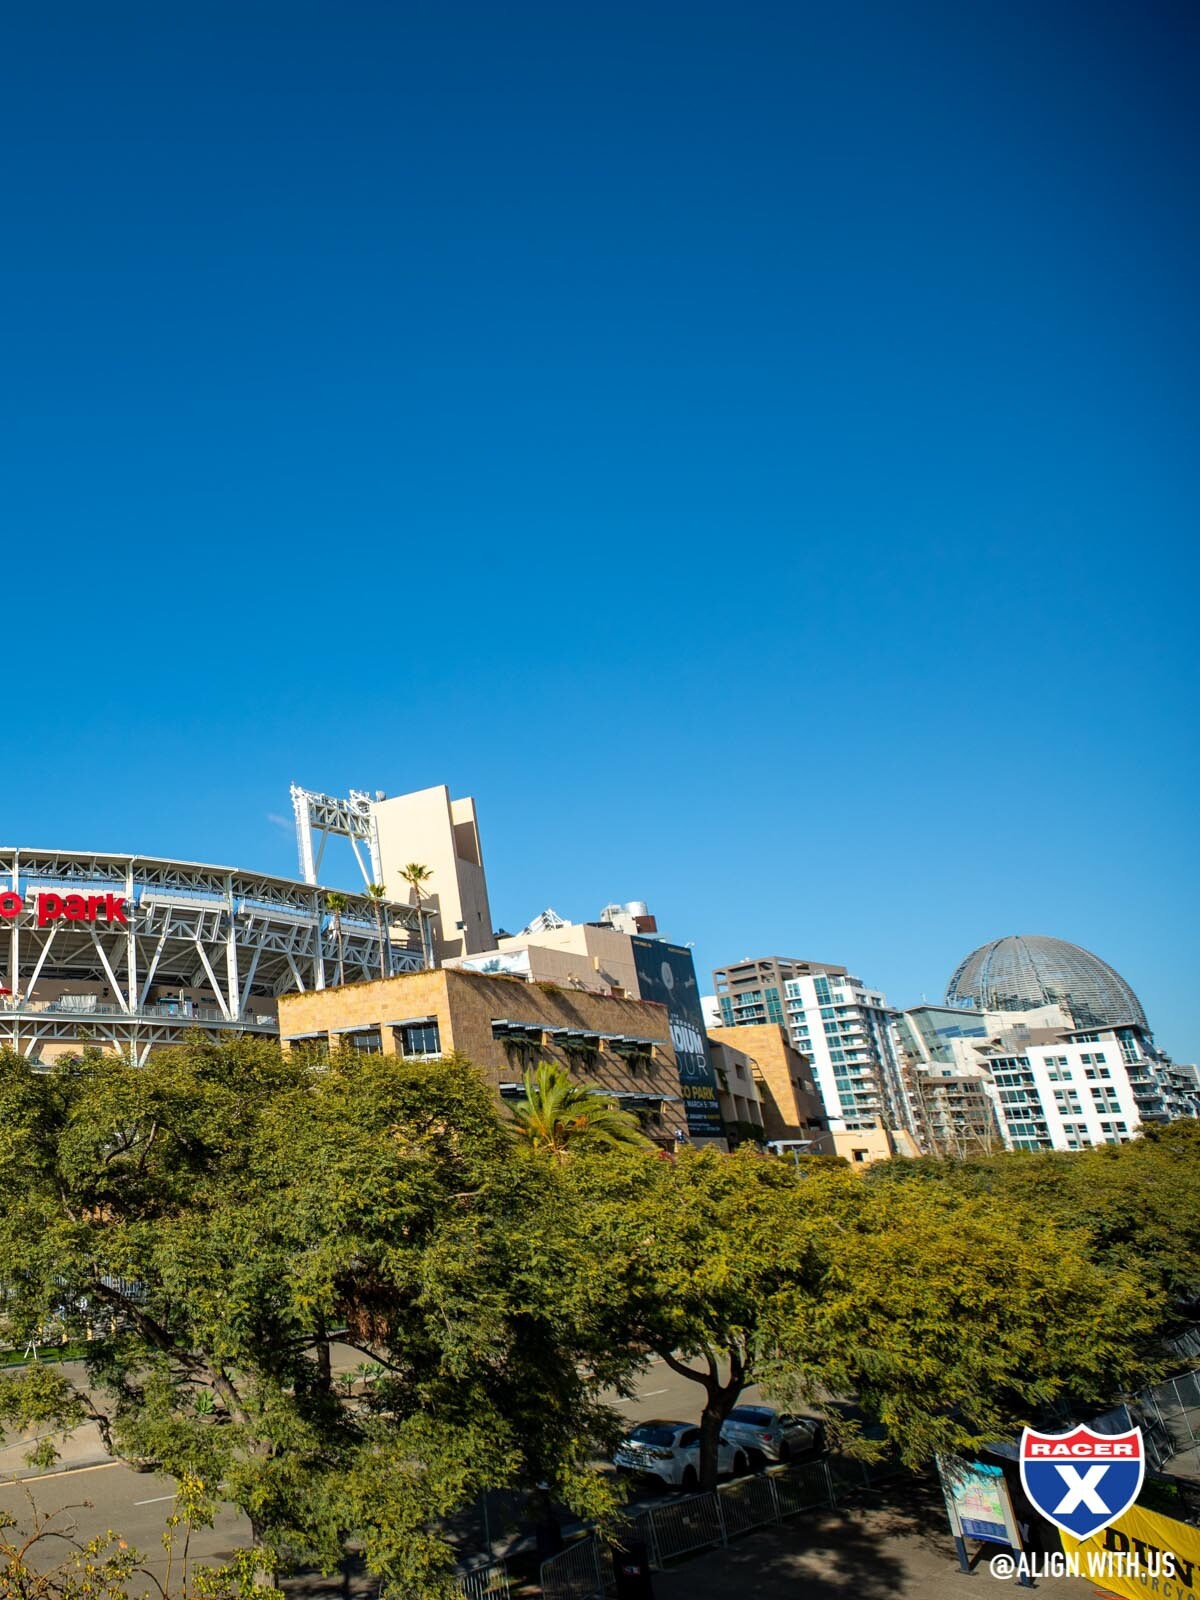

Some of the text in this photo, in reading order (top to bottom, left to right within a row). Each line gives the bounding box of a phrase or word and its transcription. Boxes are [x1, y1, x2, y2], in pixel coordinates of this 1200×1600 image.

[36, 892, 128, 927] park
[692, 1086, 715, 1100] PARK
[1103, 1526, 1200, 1589] DUN
